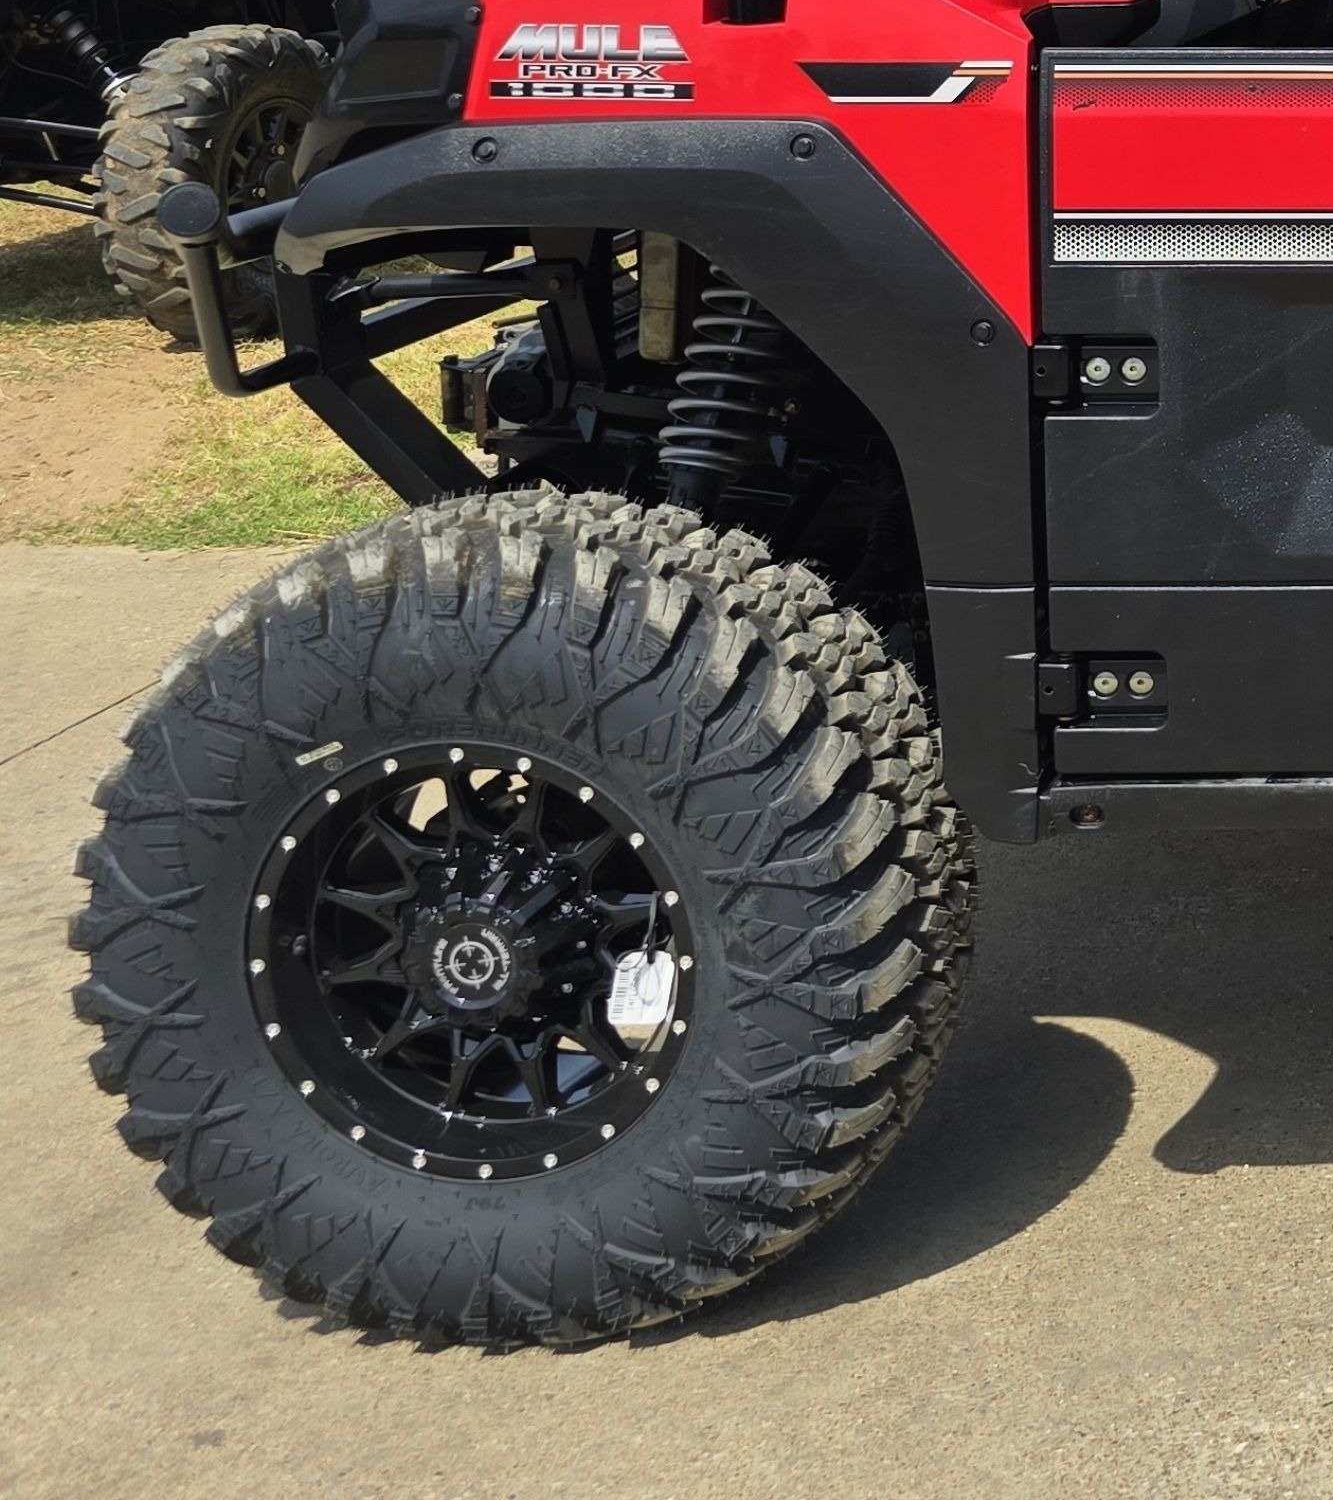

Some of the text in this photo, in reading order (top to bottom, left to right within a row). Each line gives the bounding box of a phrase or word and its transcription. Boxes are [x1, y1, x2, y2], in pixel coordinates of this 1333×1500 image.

[495, 23, 693, 63] MULE
[518, 63, 664, 80] PRO-FX
[506, 82, 678, 99] 1000
